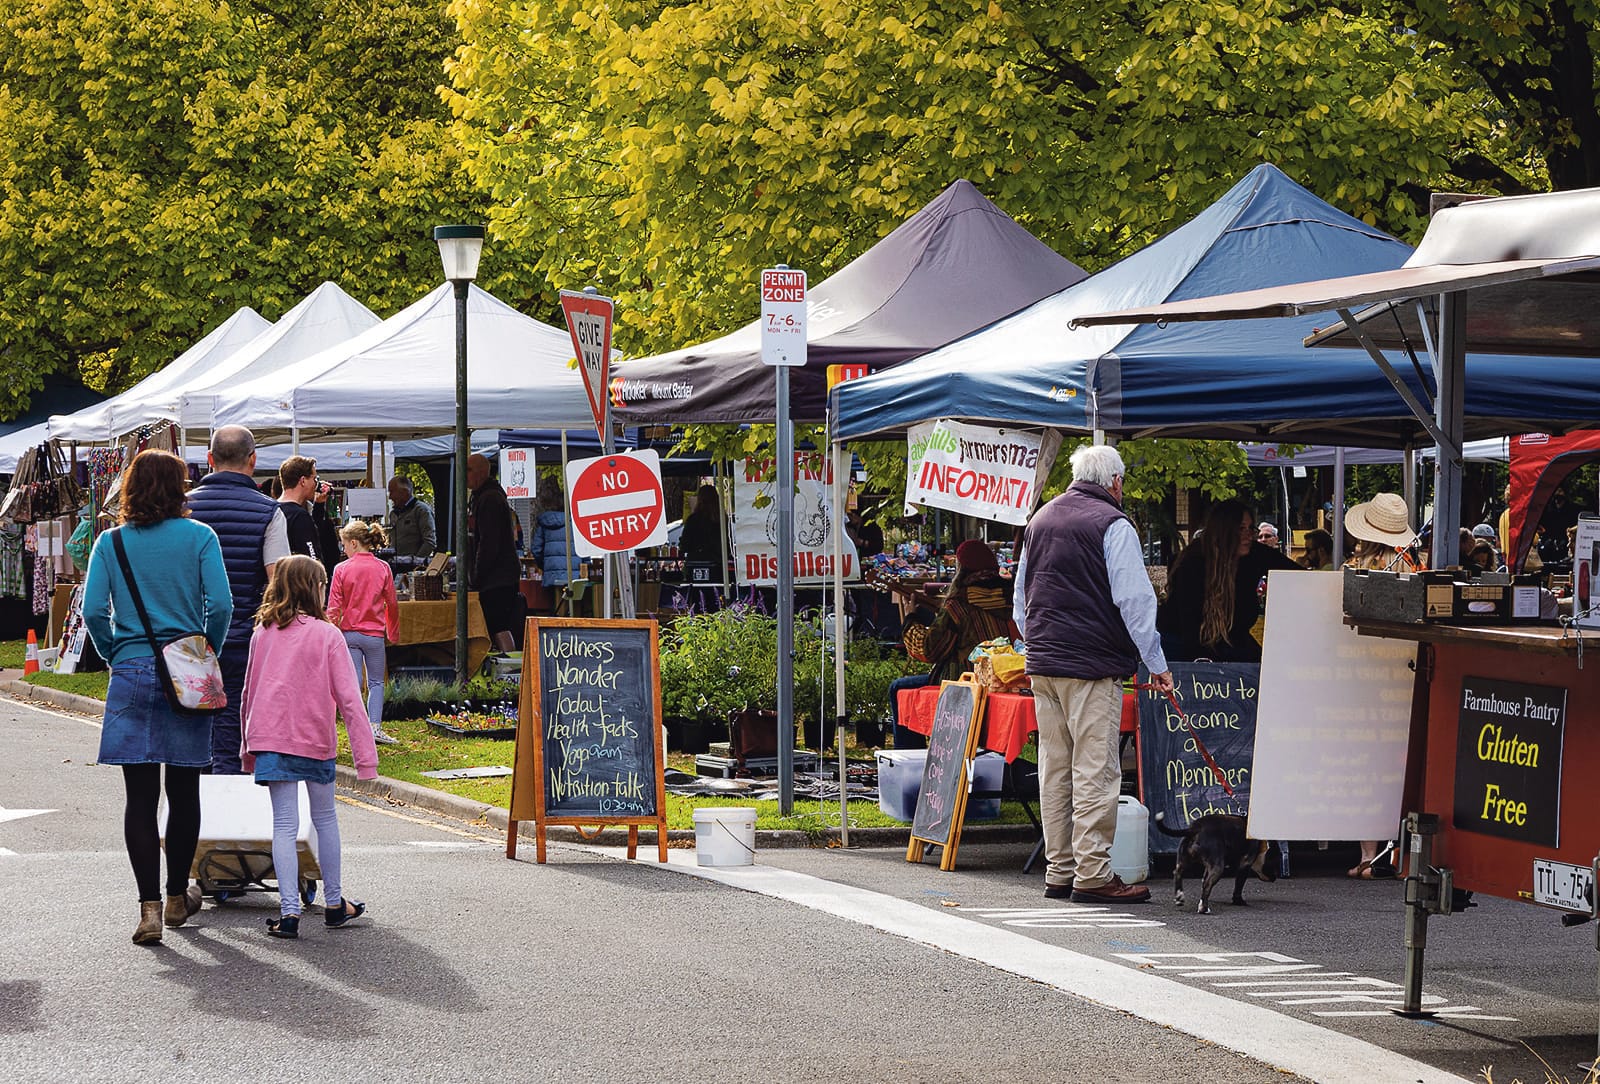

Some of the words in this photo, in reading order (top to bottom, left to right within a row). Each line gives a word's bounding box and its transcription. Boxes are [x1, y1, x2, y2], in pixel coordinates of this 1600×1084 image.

[764, 273, 803, 286] PERMIT
[764, 288, 804, 301] ZONE
[578, 320, 602, 347] GIVE
[584, 350, 601, 371] WAY
[622, 380, 647, 400] Hooker
[652, 383, 672, 399] Mount
[672, 381, 694, 400] Barker
[601, 470, 629, 491] NO
[919, 461, 1031, 509] INFORMATI
[589, 512, 652, 539] ENTRY
[543, 632, 615, 663] Wellness
[556, 659, 624, 689] Wander
[1192, 674, 1230, 700] how
[1236, 677, 1256, 700] to
[549, 687, 606, 716] Today
[1464, 689, 1521, 717] Farmhouse
[1523, 697, 1560, 726] Pantry
[547, 713, 589, 741] Health
[1165, 704, 1241, 732] become
[560, 739, 589, 775] Yoga
[1184, 738, 1199, 753] a
[1477, 723, 1539, 768] Gluten
[550, 767, 609, 802] Nutrition
[611, 771, 644, 801] talk
[1167, 756, 1249, 790] Member
[1481, 783, 1528, 826] Free
